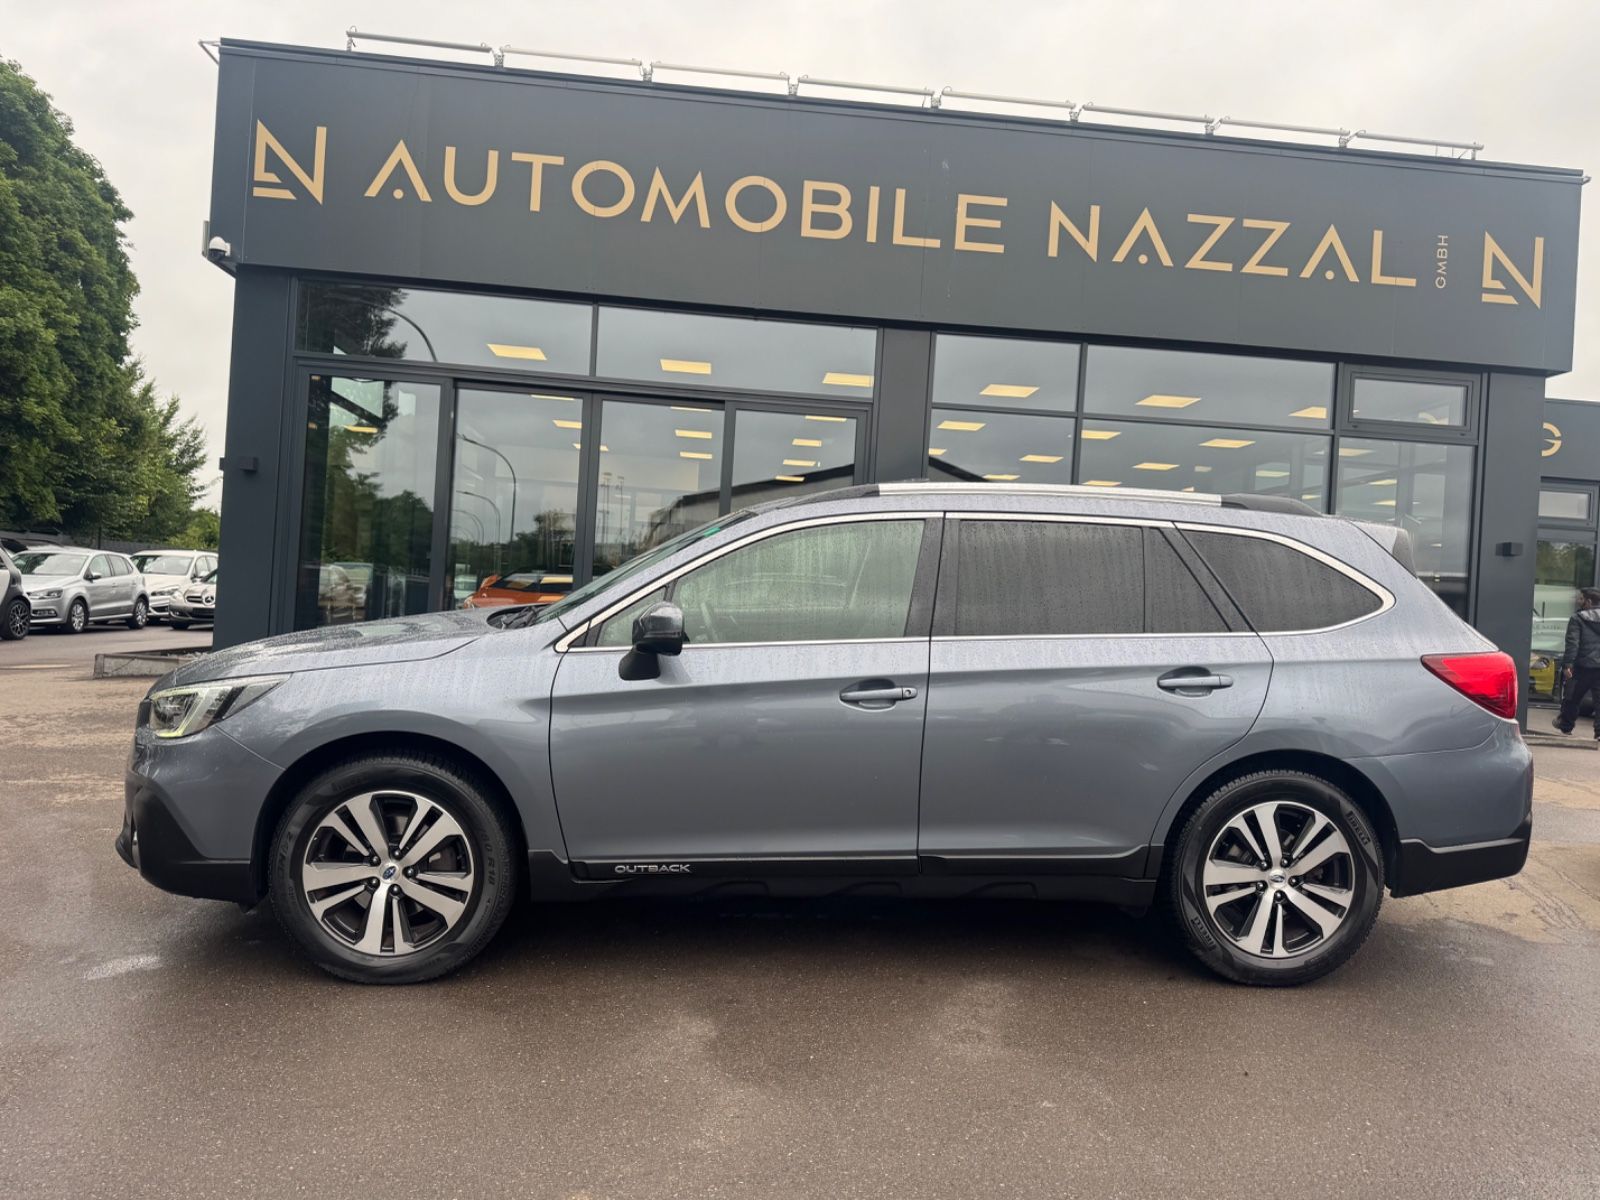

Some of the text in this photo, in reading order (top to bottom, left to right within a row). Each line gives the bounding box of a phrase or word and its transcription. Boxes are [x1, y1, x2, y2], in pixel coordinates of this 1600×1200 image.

[364, 140, 1009, 254] AUTOMOBILE
[1047, 200, 1417, 288] NAZZAL
[1435, 234, 1449, 289] GMBH
[614, 864, 692, 874] OUTBACK
